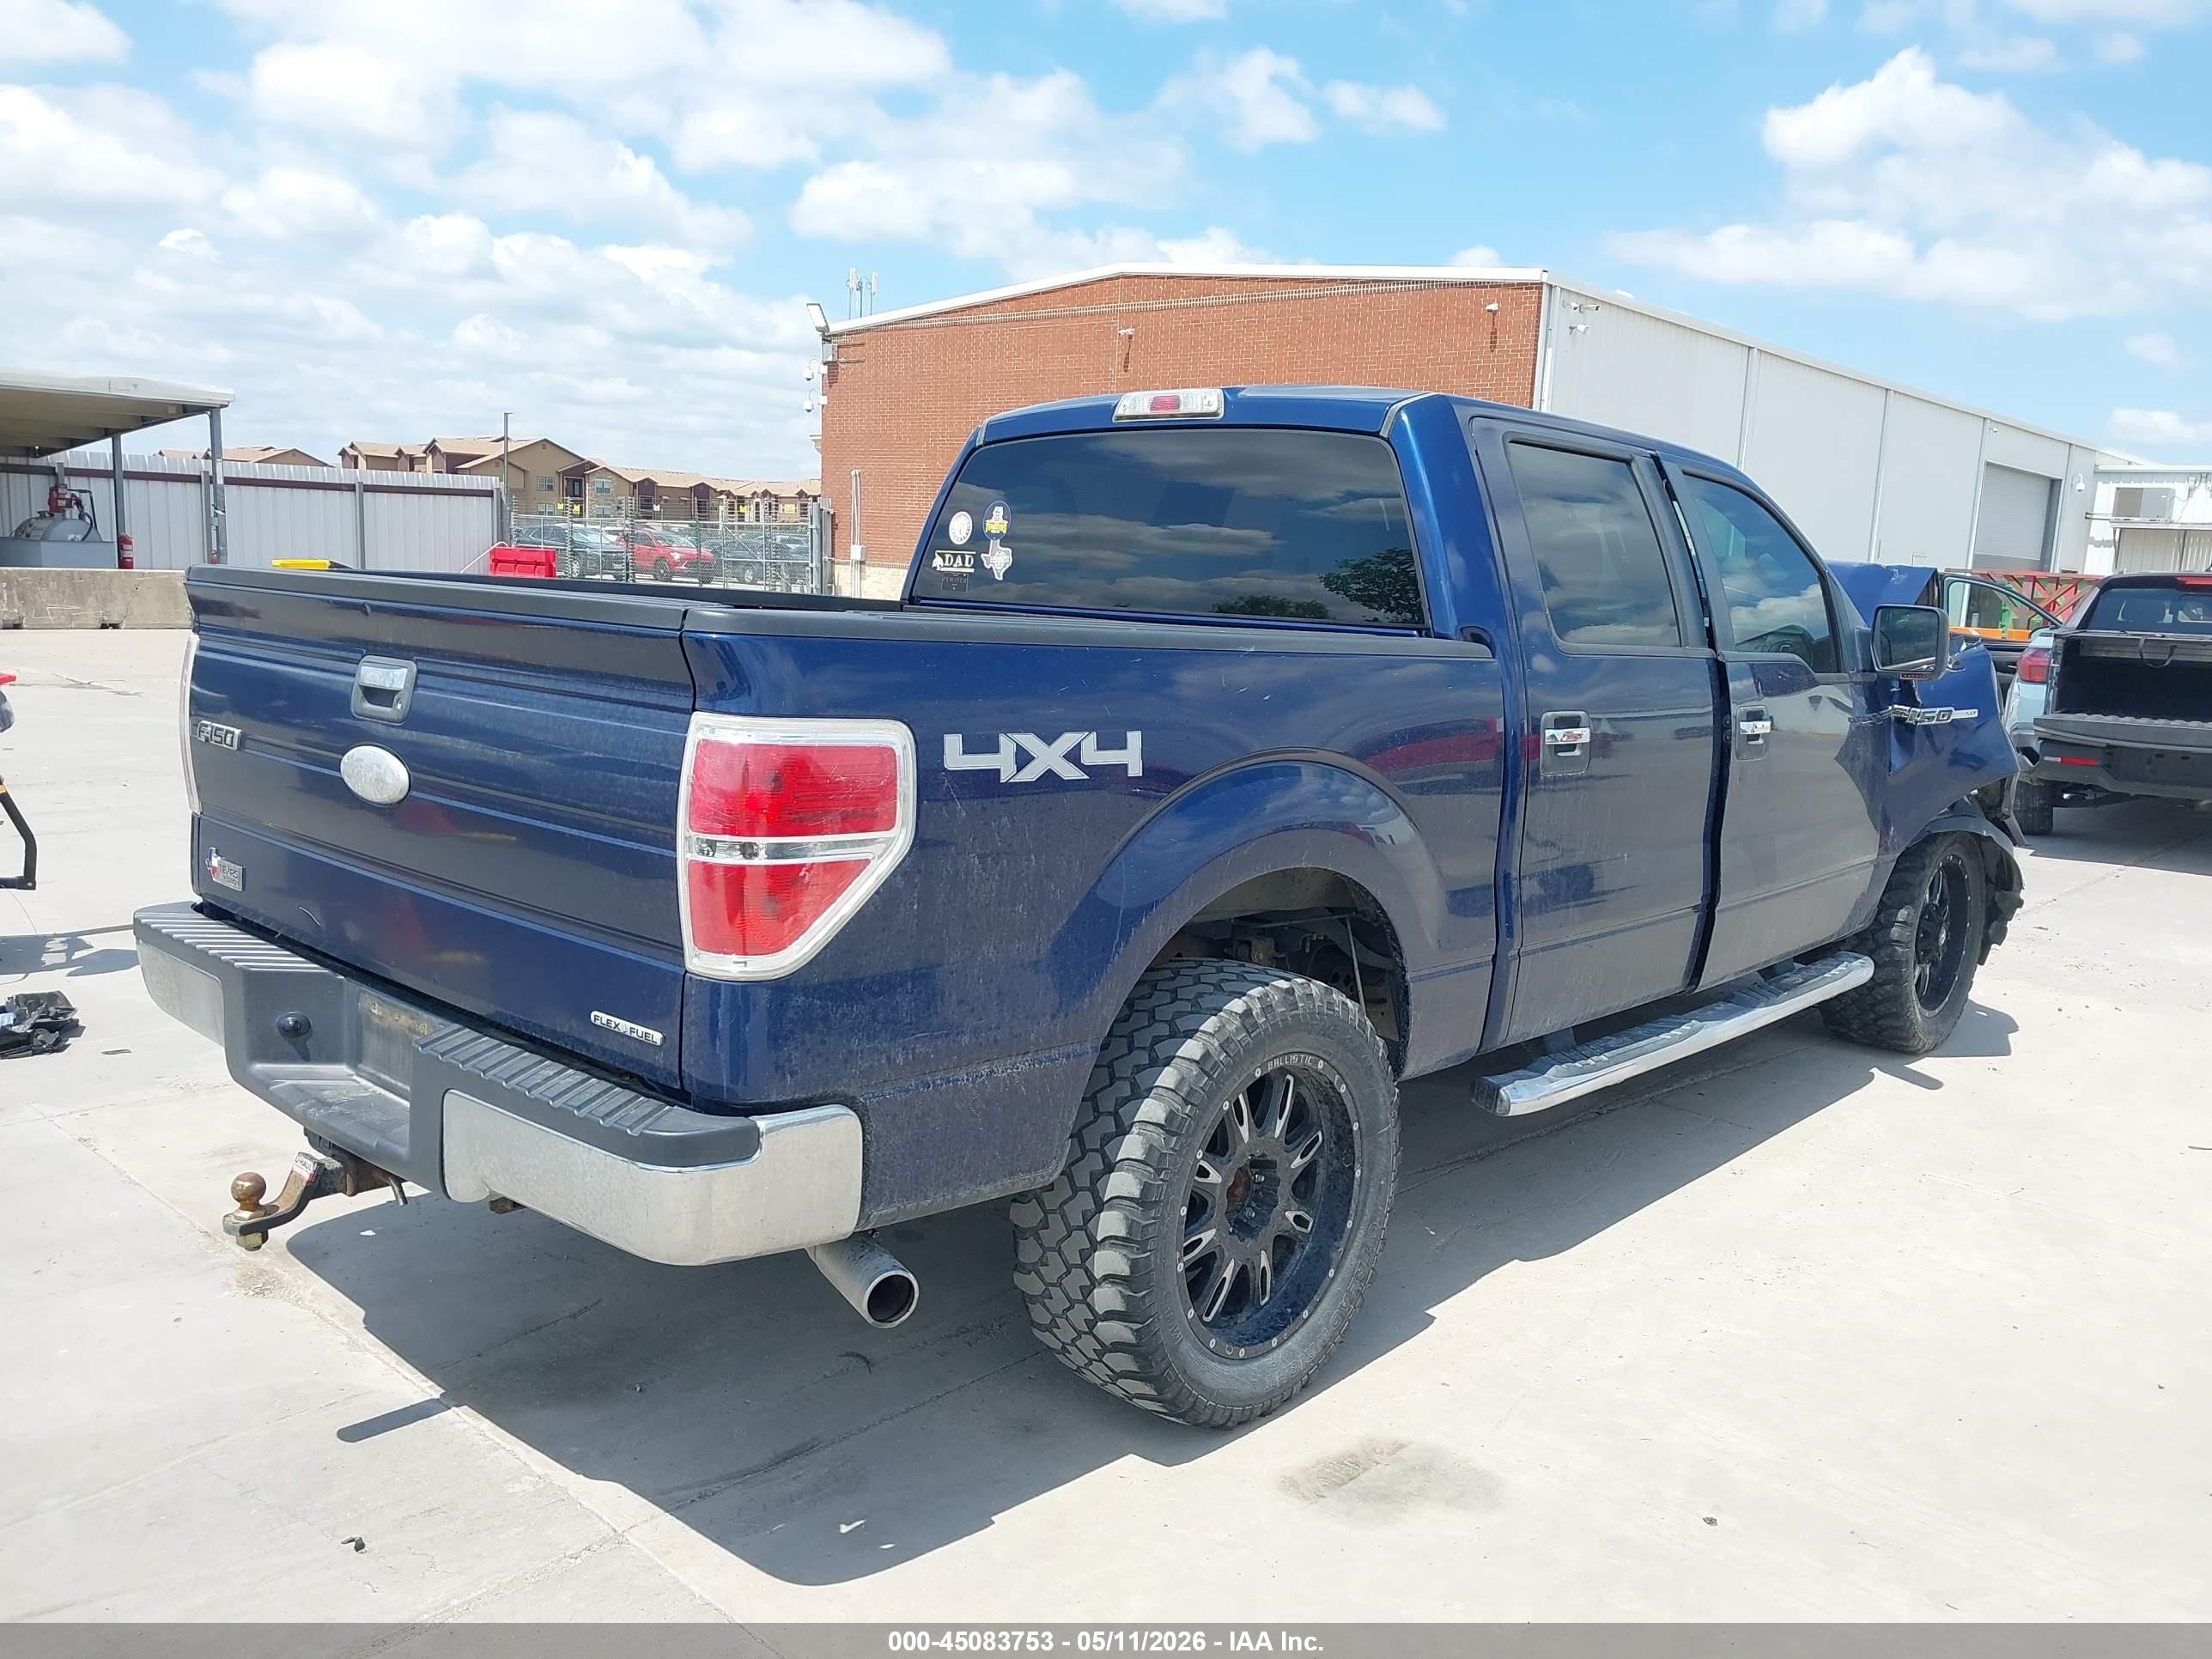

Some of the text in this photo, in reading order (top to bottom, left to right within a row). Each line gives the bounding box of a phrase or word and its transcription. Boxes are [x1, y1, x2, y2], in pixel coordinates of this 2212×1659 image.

[945, 554, 975, 568] DAD
[593, 1014, 659, 1044] FLEX FUEL
[1267, 1054, 1314, 1073] BALLISTIC
